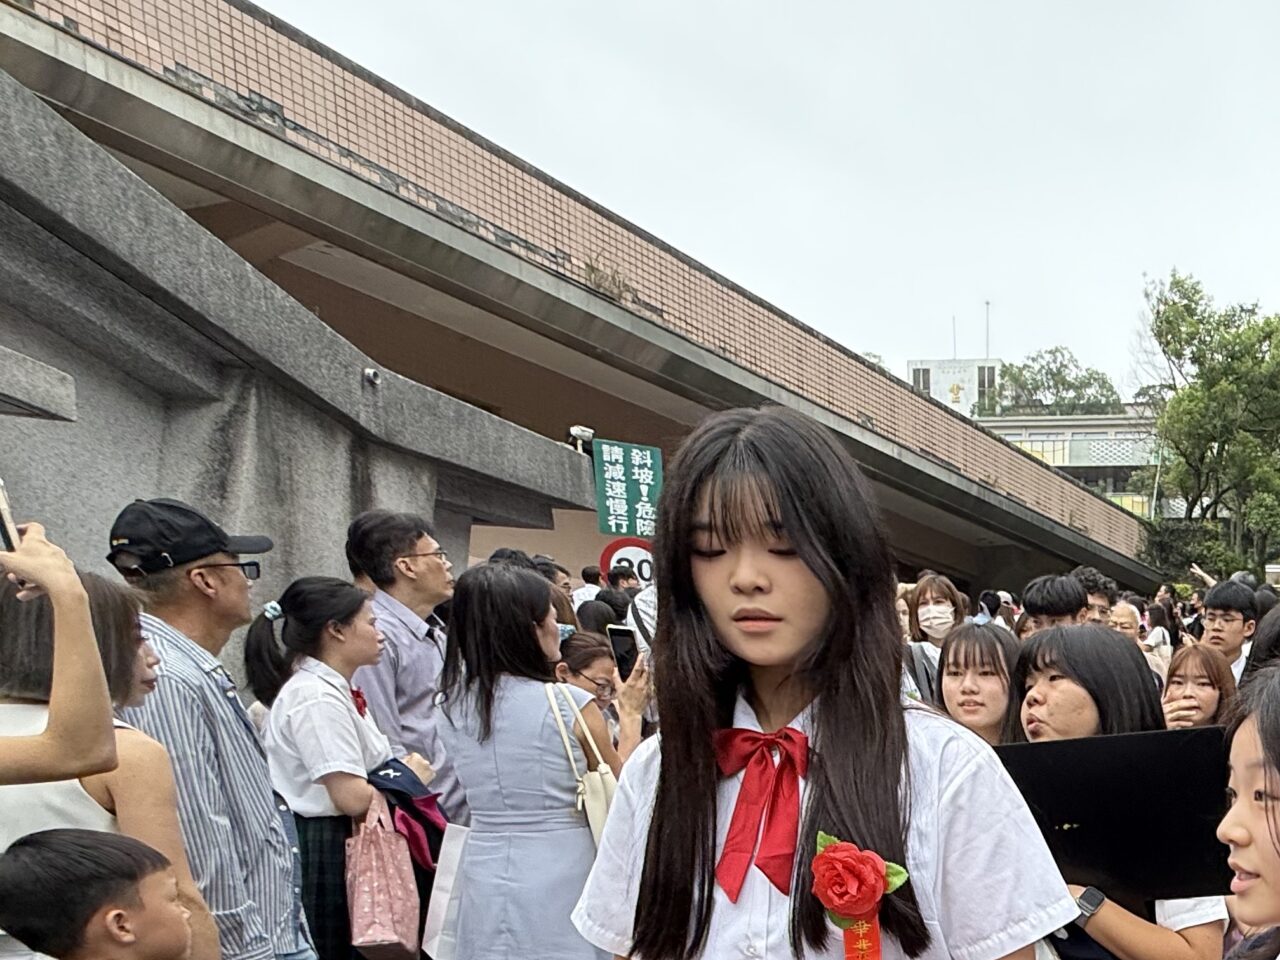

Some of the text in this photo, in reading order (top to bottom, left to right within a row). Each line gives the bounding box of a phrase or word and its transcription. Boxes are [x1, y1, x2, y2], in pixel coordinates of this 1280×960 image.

[601, 444, 629, 534] 請減速慢行
